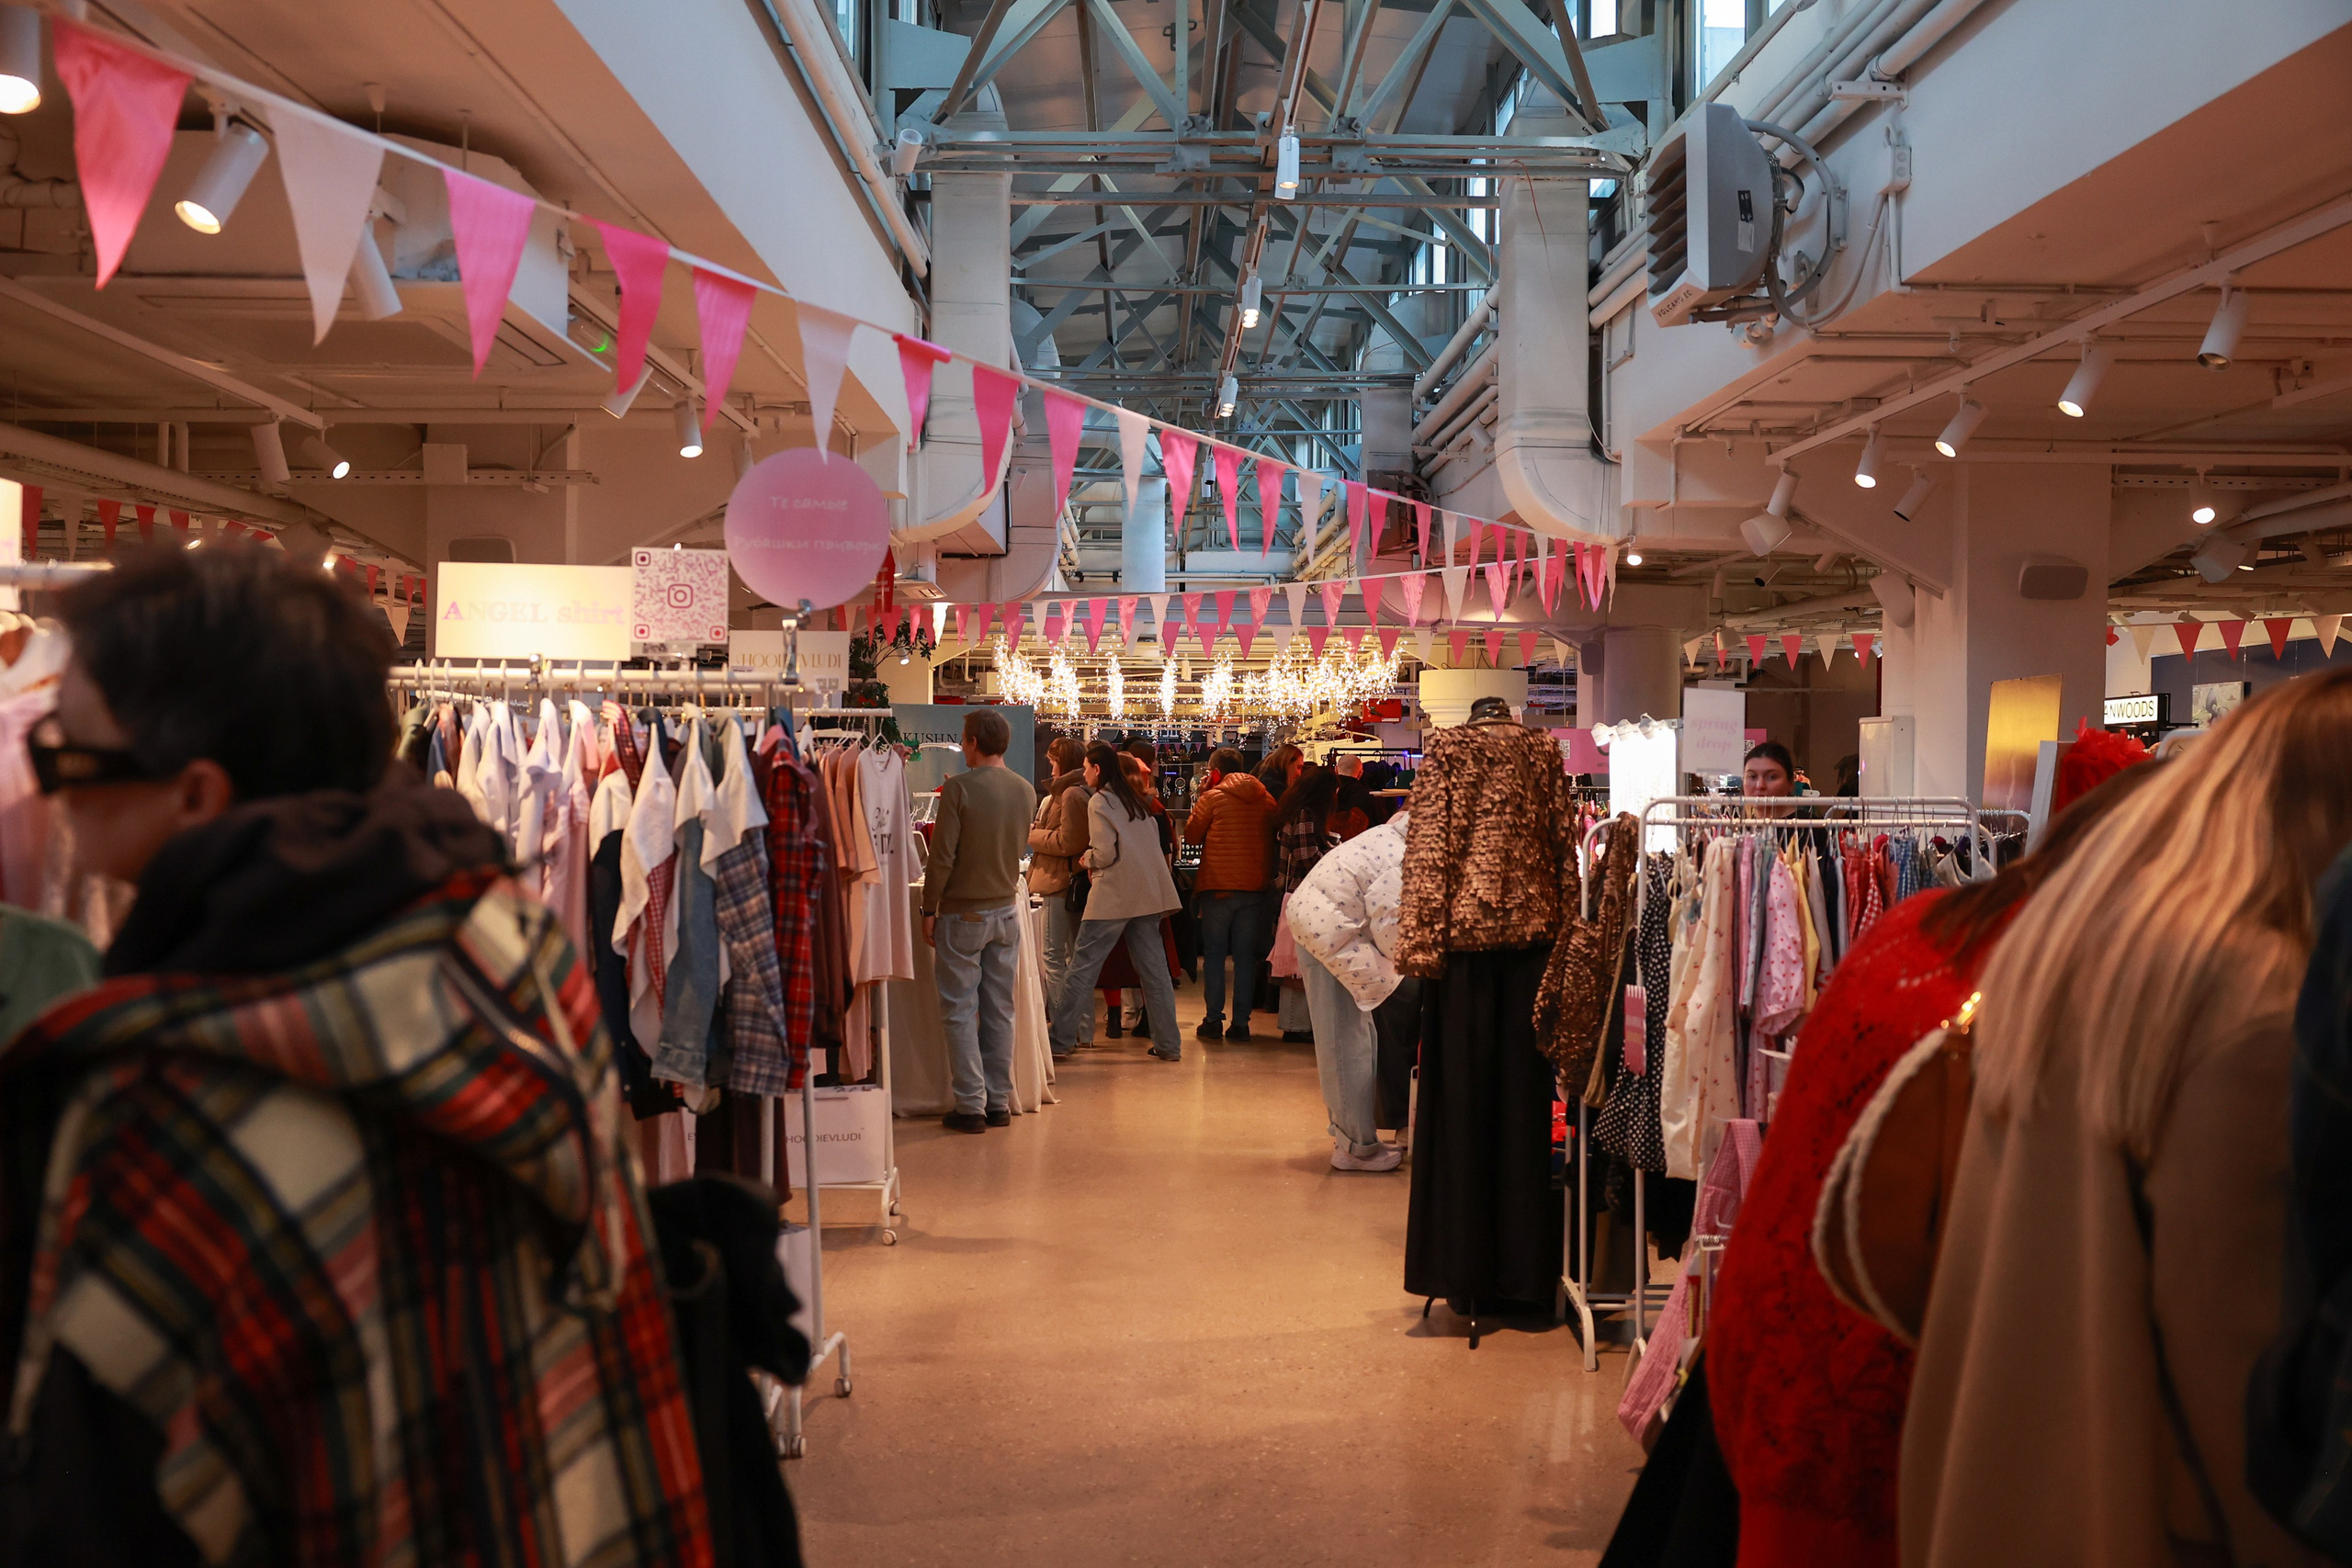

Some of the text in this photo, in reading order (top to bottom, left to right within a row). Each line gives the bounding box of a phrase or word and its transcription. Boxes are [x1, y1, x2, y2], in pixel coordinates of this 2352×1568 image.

[441, 600, 626, 625] ANGEL shirt
[1691, 717, 1737, 734] spring
[903, 732, 962, 745] KUSHN
[1697, 736, 1731, 753] drop
